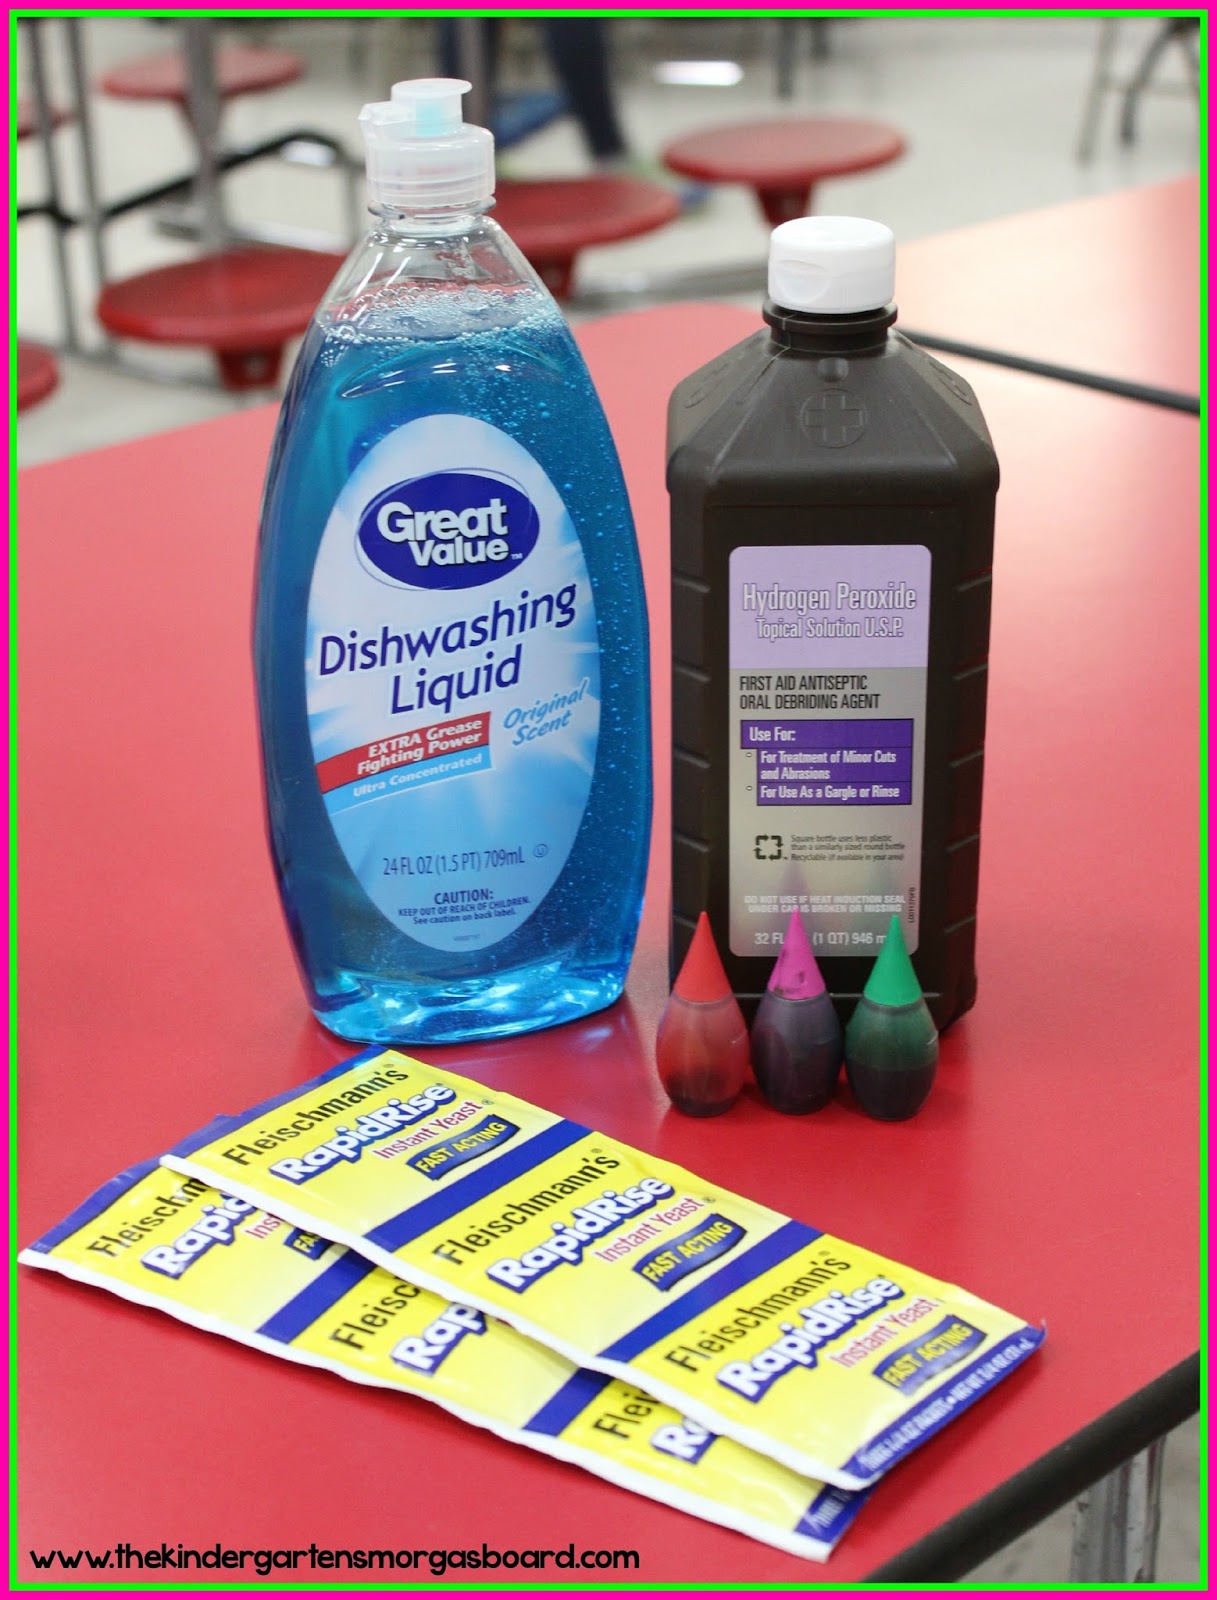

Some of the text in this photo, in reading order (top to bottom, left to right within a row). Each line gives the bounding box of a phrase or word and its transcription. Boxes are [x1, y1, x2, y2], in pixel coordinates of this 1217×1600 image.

[377, 498, 508, 543] Great
[409, 538, 509, 567] Value
[743, 581, 917, 616] Hydrogen Peroxide
[320, 583, 577, 676] Dishwashing
[756, 617, 904, 643] Topical Solution U.S.P.
[391, 643, 523, 714] Liquid
[740, 675, 868, 691] FIRST AID ANTISEPTIC
[504, 678, 588, 729] Original
[740, 693, 880, 710] ORAL DEBRIDING AGENT
[368, 718, 482, 758] EXTRA Grease
[512, 710, 571, 746] Scent
[749, 726, 796, 742] Use For:
[357, 731, 482, 775] Fighting Power
[760, 750, 897, 764] For Treatment of Minor Cuts
[760, 767, 831, 780] and Abrasions
[353, 754, 482, 797] Ultra Concentrated
[760, 785, 900, 800] For Use As a Gargle or Rinse
[791, 835, 814, 843] Square
[869, 834, 892, 843] plastic
[791, 854, 826, 862] Recyclable
[872, 854, 886, 862] your
[814, 843, 842, 852] similarly
[885, 842, 905, 850] bottle
[383, 856, 398, 876] 24
[401, 856, 415, 875] FL
[417, 855, 433, 874] OZ
[435, 853, 459, 876] (1.5
[461, 851, 482, 872] PT)
[484, 846, 525, 868] 709mL
[398, 908, 418, 916] KEEP
[420, 907, 436, 916] OUT
[438, 906, 448, 915] OF
[450, 904, 476, 913] REACH
[478, 902, 488, 911] OF
[434, 888, 494, 905] CAUTION:
[744, 895, 906, 904] DO NOT USE IF HEAT INDUCTION SEAL
[748, 904, 779, 913] UNDER
[801, 904, 810, 912] IS
[811, 904, 847, 912] BROKEN
[849, 904, 862, 912] OR
[864, 904, 902, 912] MISSING
[413, 917, 428, 925] See
[430, 915, 460, 923] caution
[474, 911, 492, 920] back
[754, 933, 769, 945] 32
[772, 932, 784, 944] FL
[813, 932, 824, 945] (1
[827, 932, 850, 945] QT)
[852, 932, 873, 944] 946
[222, 1067, 409, 1166] Fleischmann's
[269, 1084, 456, 1185] RapidRise
[372, 1100, 483, 1160] Instant Yeast
[415, 1121, 508, 1174] FAST ACTING
[88, 1178, 211, 1258] Fleischm
[433, 1154, 620, 1266] Fleischmann's
[595, 1197, 705, 1263] Instant Yeast
[486, 1178, 675, 1294] RapidRise
[642, 1220, 733, 1282] FAST ACTING
[329, 1276, 422, 1350] Fleisc
[664, 1256, 851, 1374] Fleischmann's
[830, 1297, 938, 1367] Instant Yeast
[390, 1302, 488, 1377] Rap
[715, 1277, 904, 1402] RapidRise
[883, 1321, 973, 1387] FAST ACTING
